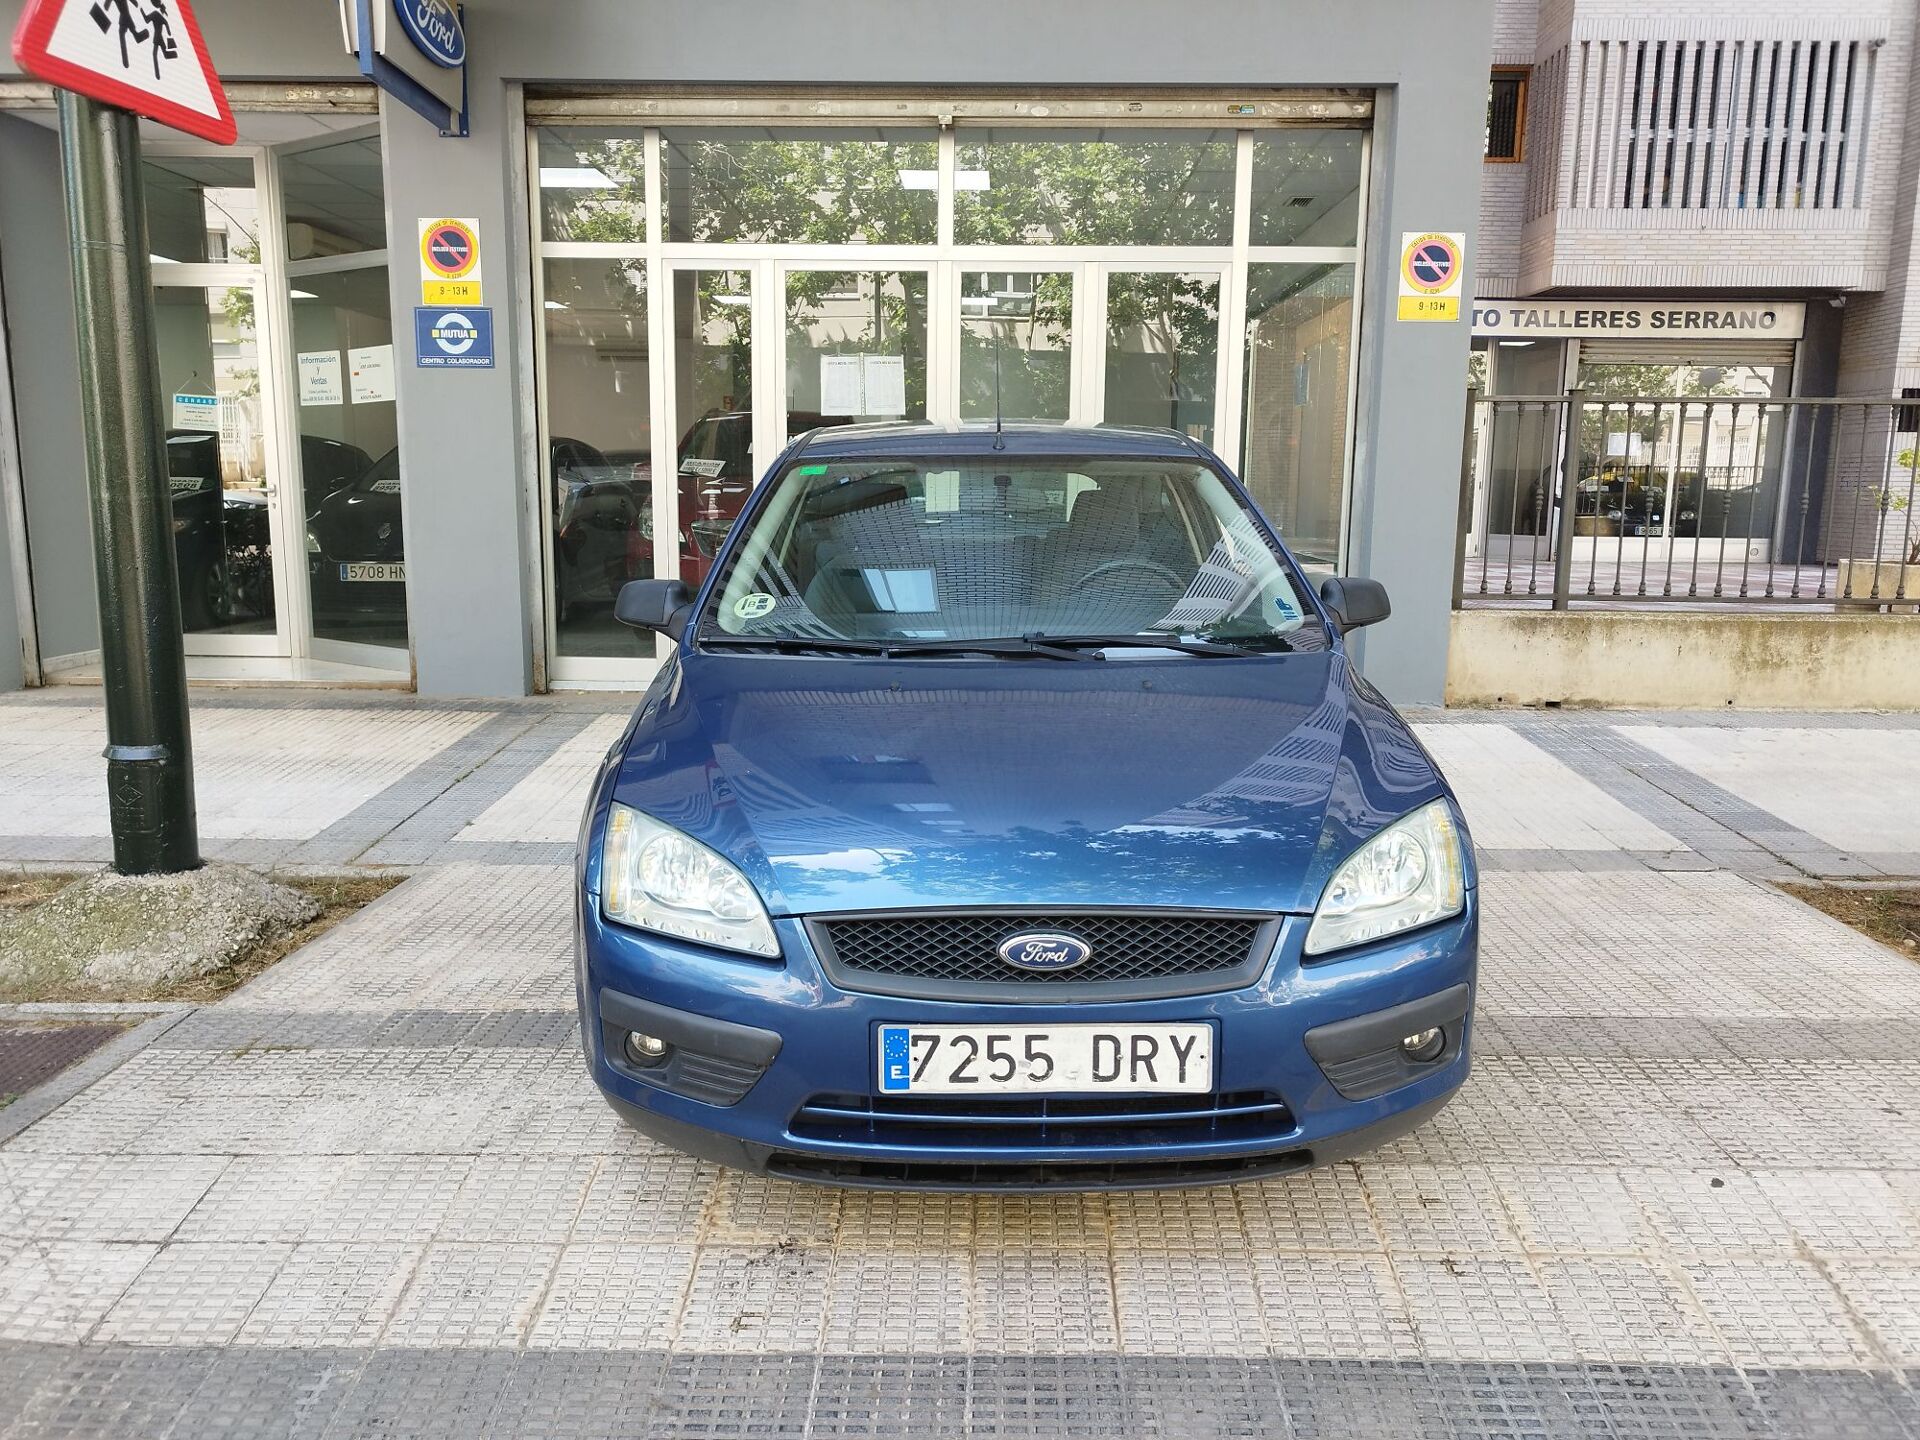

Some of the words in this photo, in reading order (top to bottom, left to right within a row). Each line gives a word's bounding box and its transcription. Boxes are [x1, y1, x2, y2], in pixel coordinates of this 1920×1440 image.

[417, 0, 456, 54] Ford
[1510, 309, 1641, 328] TALLERES
[1650, 310, 1777, 329] SERRANO
[440, 329, 469, 338] MUTUA
[300, 356, 337, 365] Información
[310, 377, 328, 385] Ventas
[349, 566, 385, 579] 5708
[1020, 941, 1069, 963] Ford
[891, 1065, 903, 1079] E
[911, 1034, 1055, 1083] 7255
[1092, 1034, 1198, 1083] DRY
